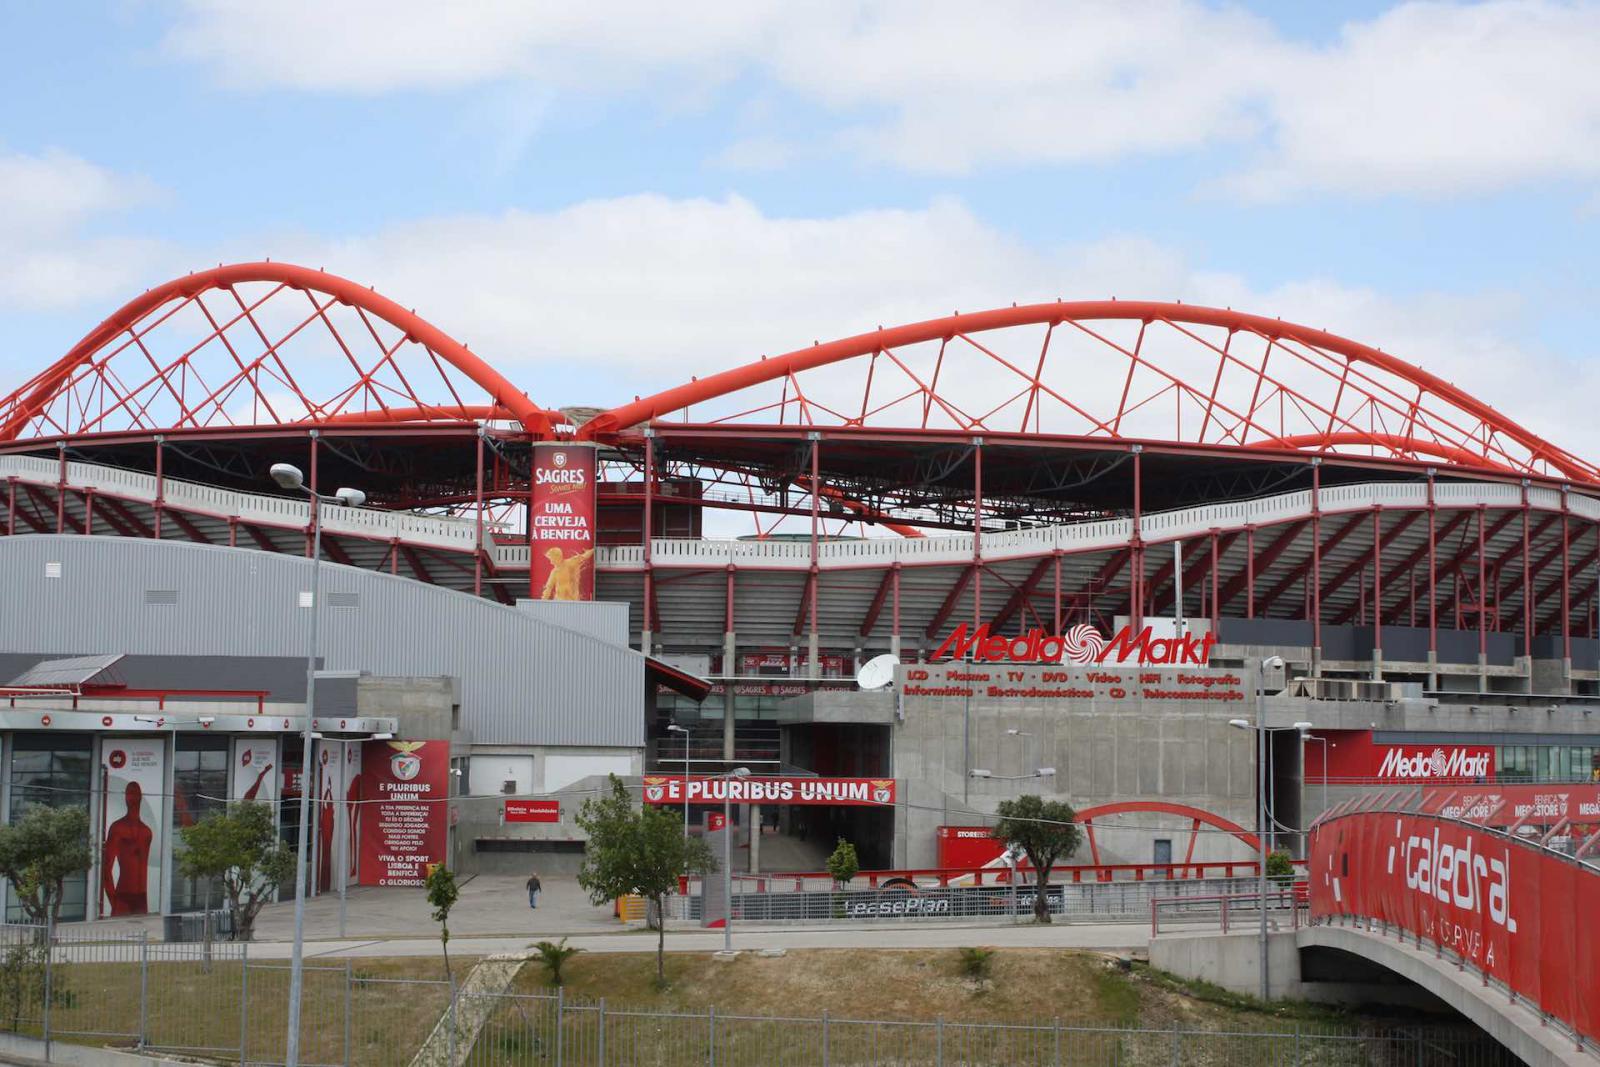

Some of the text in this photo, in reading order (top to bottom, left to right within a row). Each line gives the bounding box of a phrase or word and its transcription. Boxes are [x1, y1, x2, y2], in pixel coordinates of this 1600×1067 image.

[535, 468, 585, 485] SAGRES
[545, 503, 573, 514] UMA
[534, 516, 587, 527] CERVEJA
[532, 527, 591, 540] À BENFICA
[929, 623, 1216, 664] Media Markt
[907, 670, 929, 681] LCD
[946, 670, 990, 682] Plasma
[1007, 671, 1024, 682] TV
[1041, 671, 1068, 683] DVD
[1177, 673, 1241, 687] Fotografia
[740, 685, 767, 694] SAGRES
[780, 685, 806, 694] SAGRES
[903, 684, 1244, 702] Informática Electrodomésticos CD Telecomunicação
[1377, 748, 1490, 777] Media Markt
[379, 783, 431, 792] E PLURIBUS
[669, 780, 869, 801] E PLURIBUS UNUM
[390, 793, 419, 801] UNUM
[1463, 796, 1489, 806] BENA
[1534, 794, 1559, 804] BENFICA
[1406, 827, 1517, 934] catedral
[845, 897, 949, 915] LeasePlan
